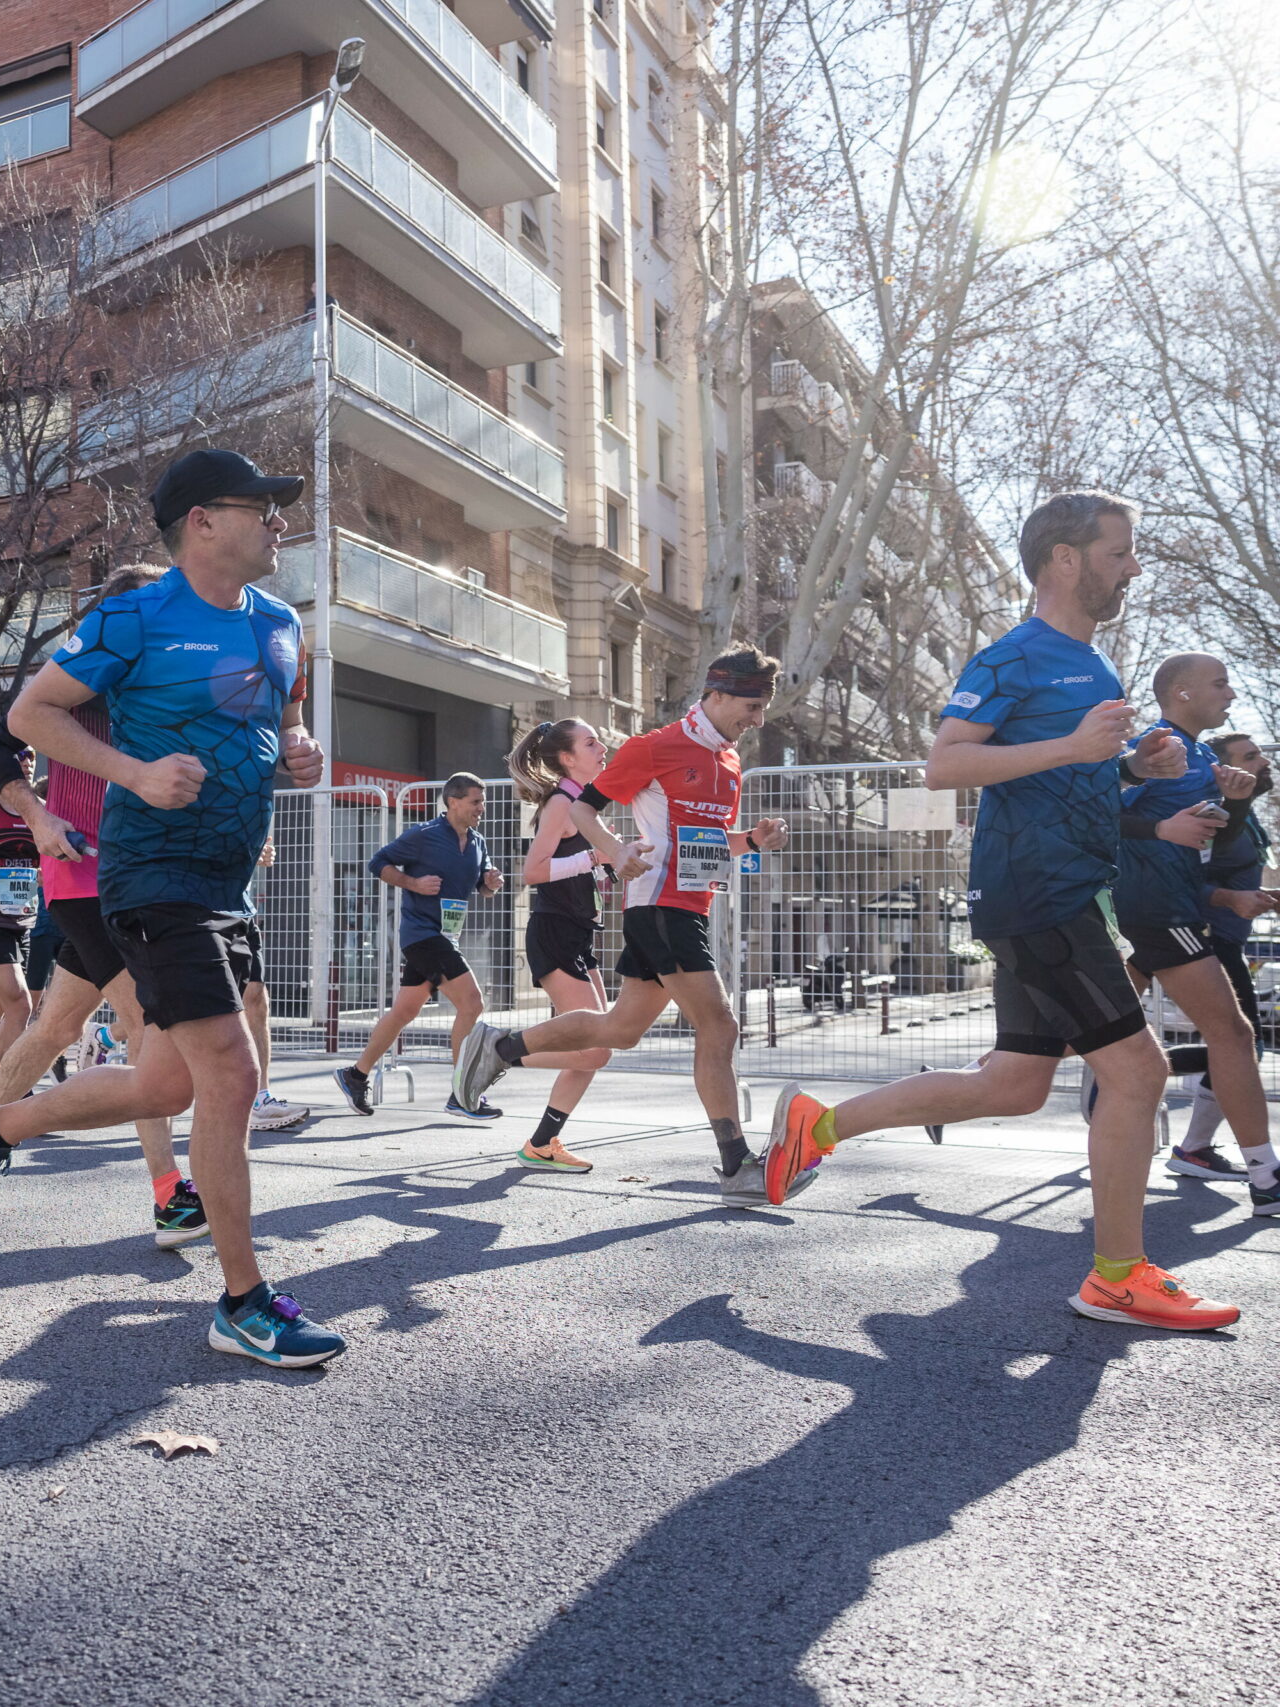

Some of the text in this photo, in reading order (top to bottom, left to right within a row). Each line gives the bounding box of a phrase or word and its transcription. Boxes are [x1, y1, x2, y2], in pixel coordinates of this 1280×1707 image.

[183, 642, 219, 651] BROOKS
[1063, 675, 1094, 684] BROOKS
[10, 881, 31, 892] MARC
